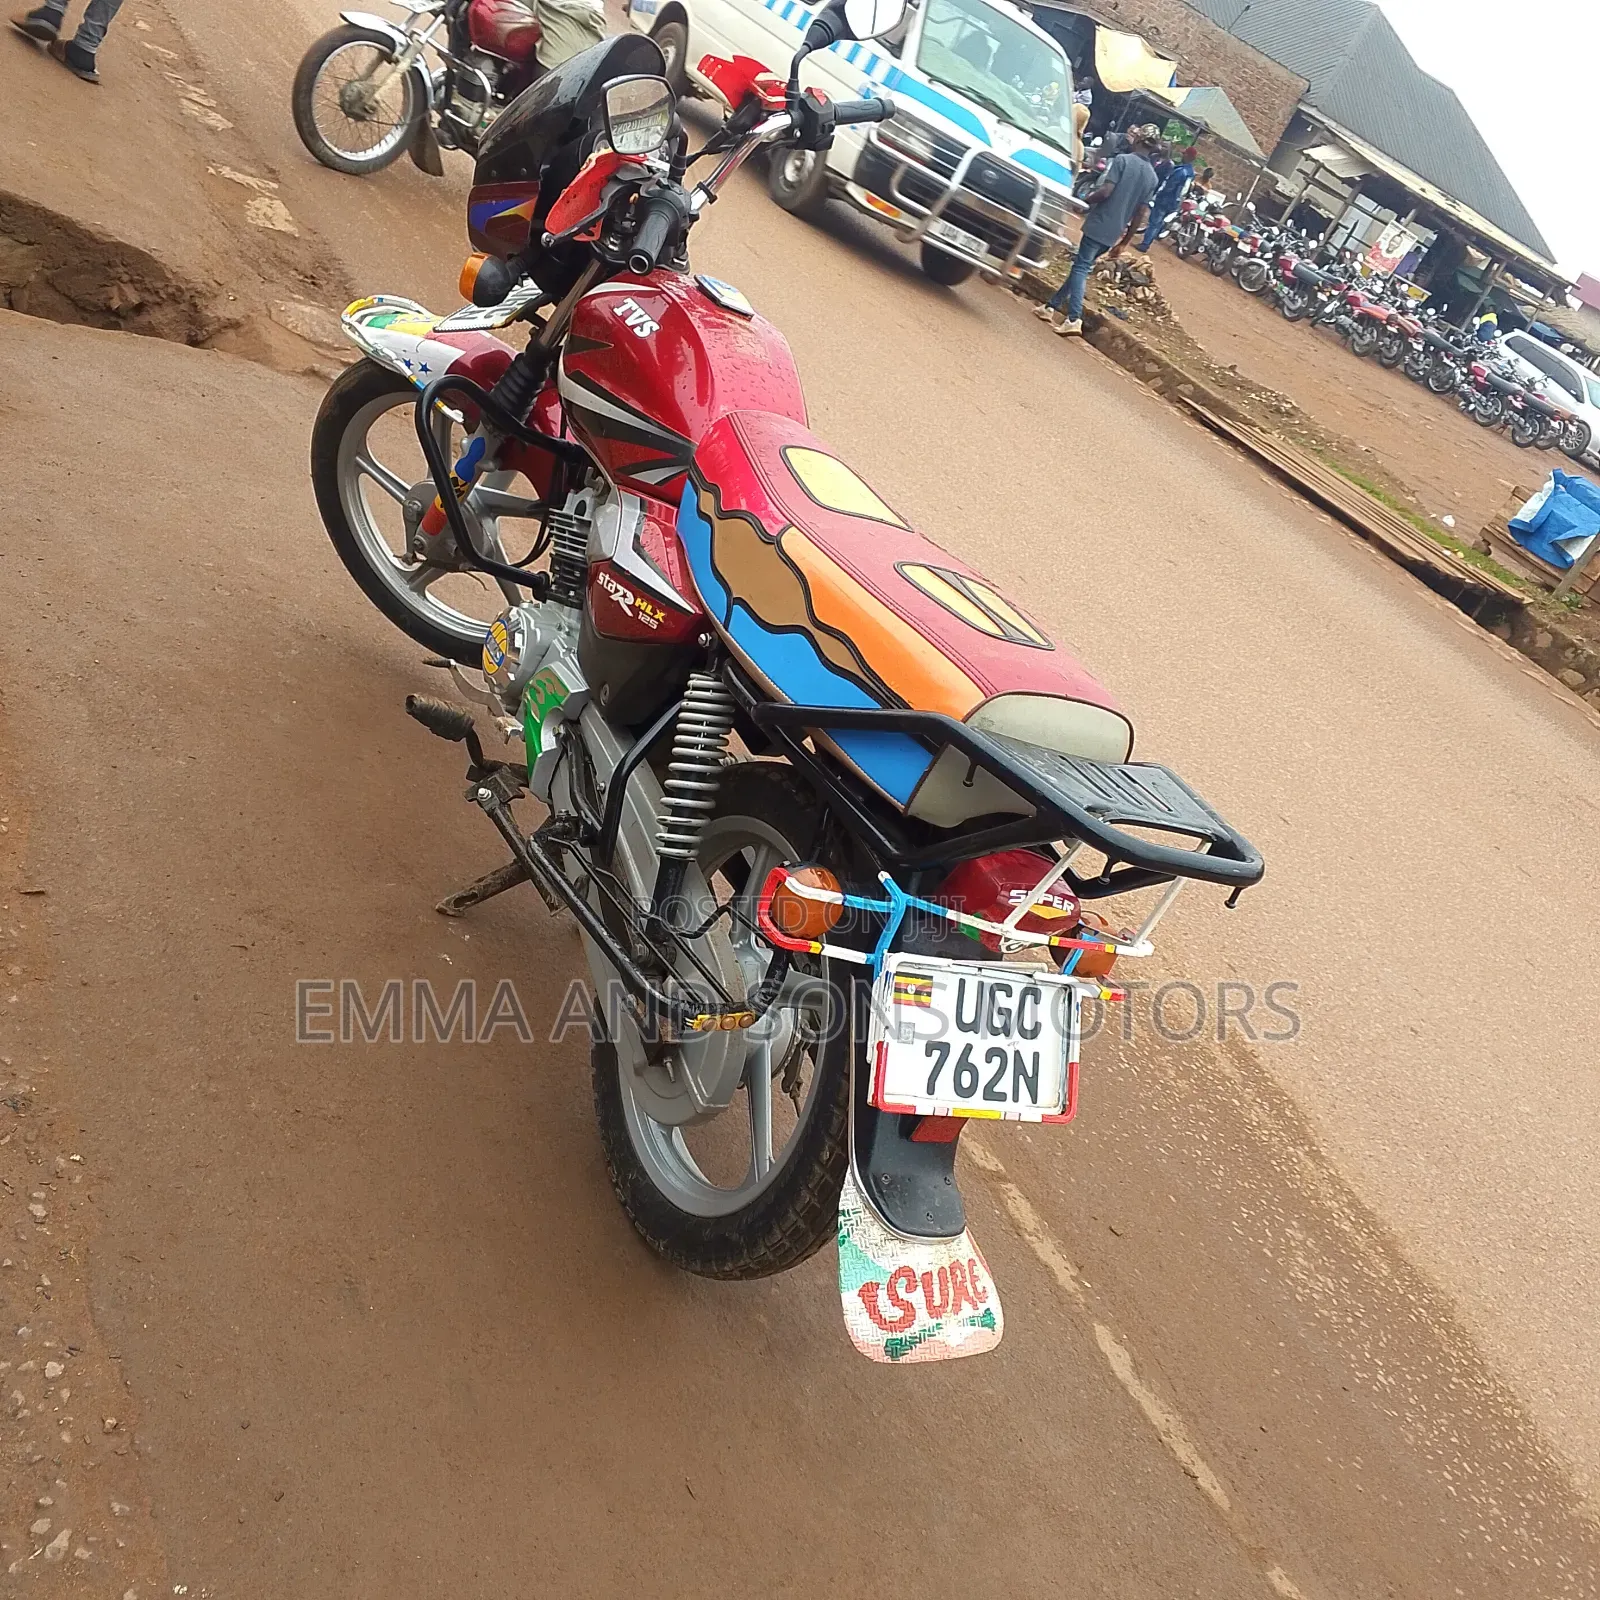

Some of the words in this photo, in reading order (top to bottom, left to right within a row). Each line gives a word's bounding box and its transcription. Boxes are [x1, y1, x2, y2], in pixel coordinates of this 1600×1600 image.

[612, 297, 661, 338] TVS
[634, 597, 666, 623] HLX
[637, 610, 660, 630] 125
[955, 977, 1042, 1040] UGC
[924, 1039, 1040, 1105] 762N
